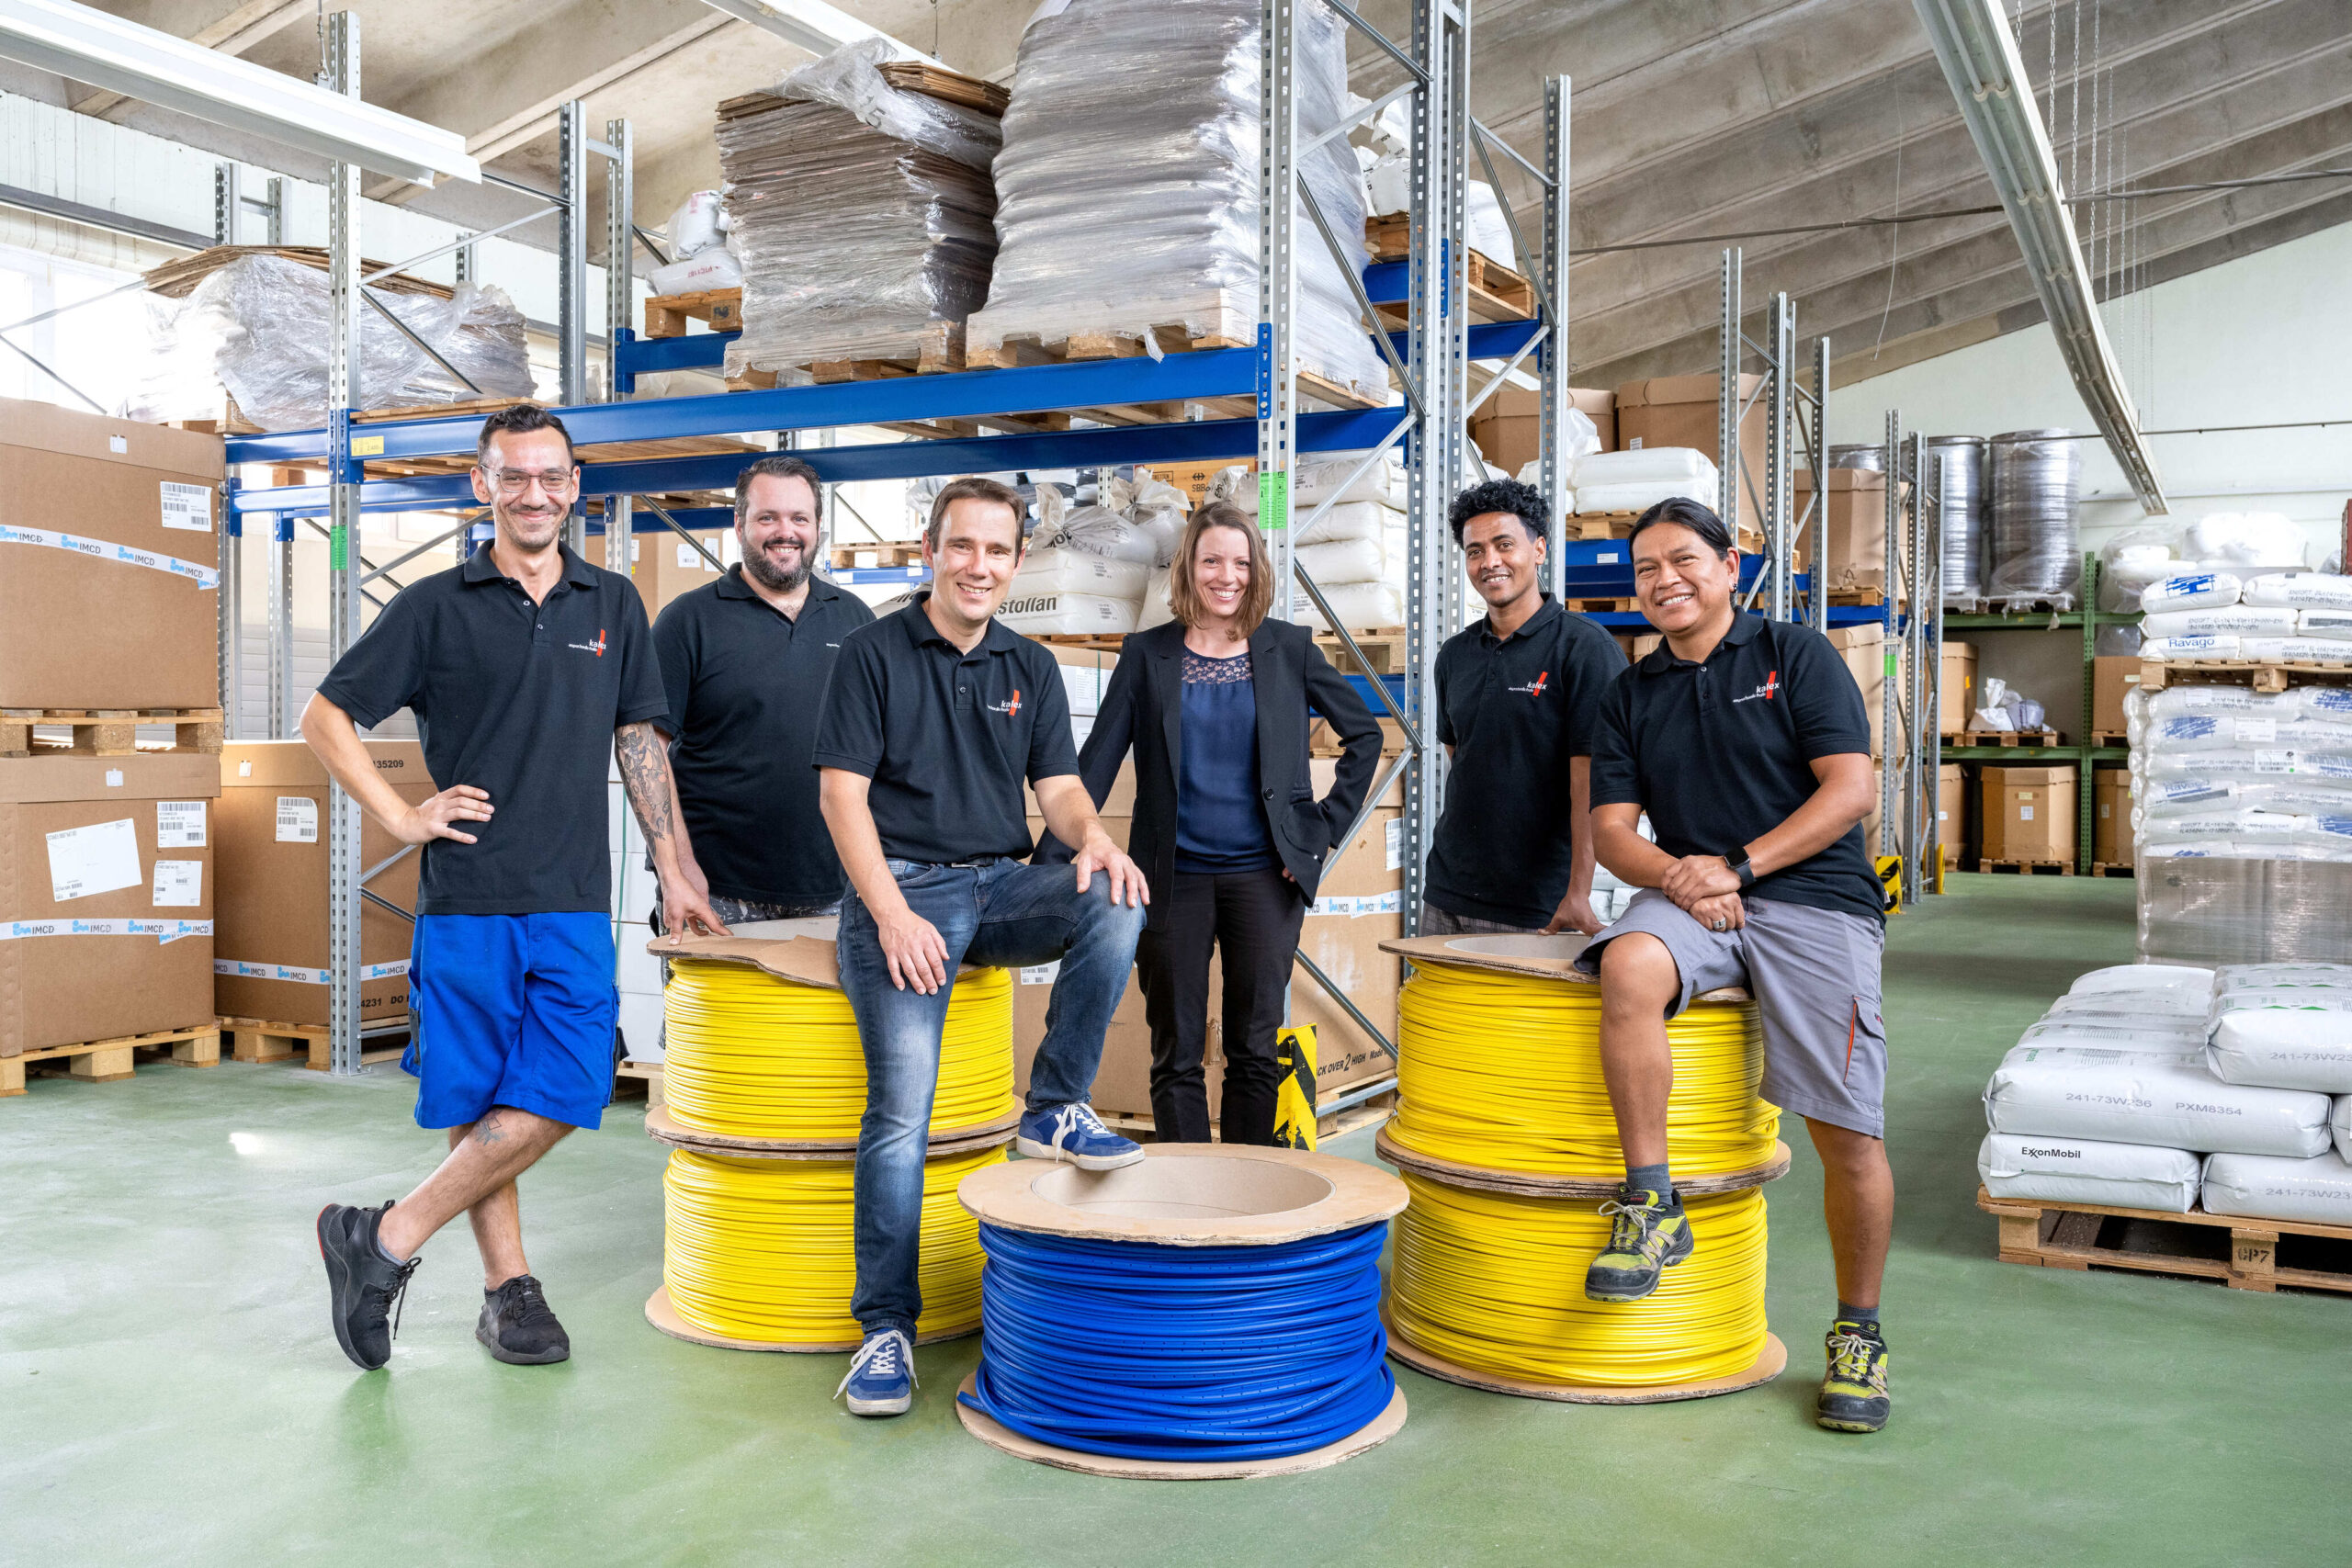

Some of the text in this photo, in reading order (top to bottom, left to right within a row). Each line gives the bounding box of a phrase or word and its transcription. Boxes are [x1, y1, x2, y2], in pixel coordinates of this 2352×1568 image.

[19, 533, 203, 579] IMCD IMCD IMCD IMCD
[994, 597, 1057, 615] stollan
[2168, 637, 2215, 649] Ravago
[1757, 682, 1780, 694] kalex
[1001, 700, 1022, 708] kalex
[32, 924, 209, 935] IMCD IMCD IMCD IMCD
[250, 968, 266, 976] IMCD
[290, 972, 307, 981] IMCD
[387, 965, 405, 976] IMCD
[390, 995, 403, 1004] DO
[1328, 1060, 1344, 1073] OVER
[1343, 1053, 1351, 1071] 2
[1351, 1053, 1366, 1066] HIGH
[1370, 1049, 1383, 1060] Made
[2176, 1102, 2242, 1116] PXM8354
[2021, 1146, 2081, 1158] ExxonMobil
